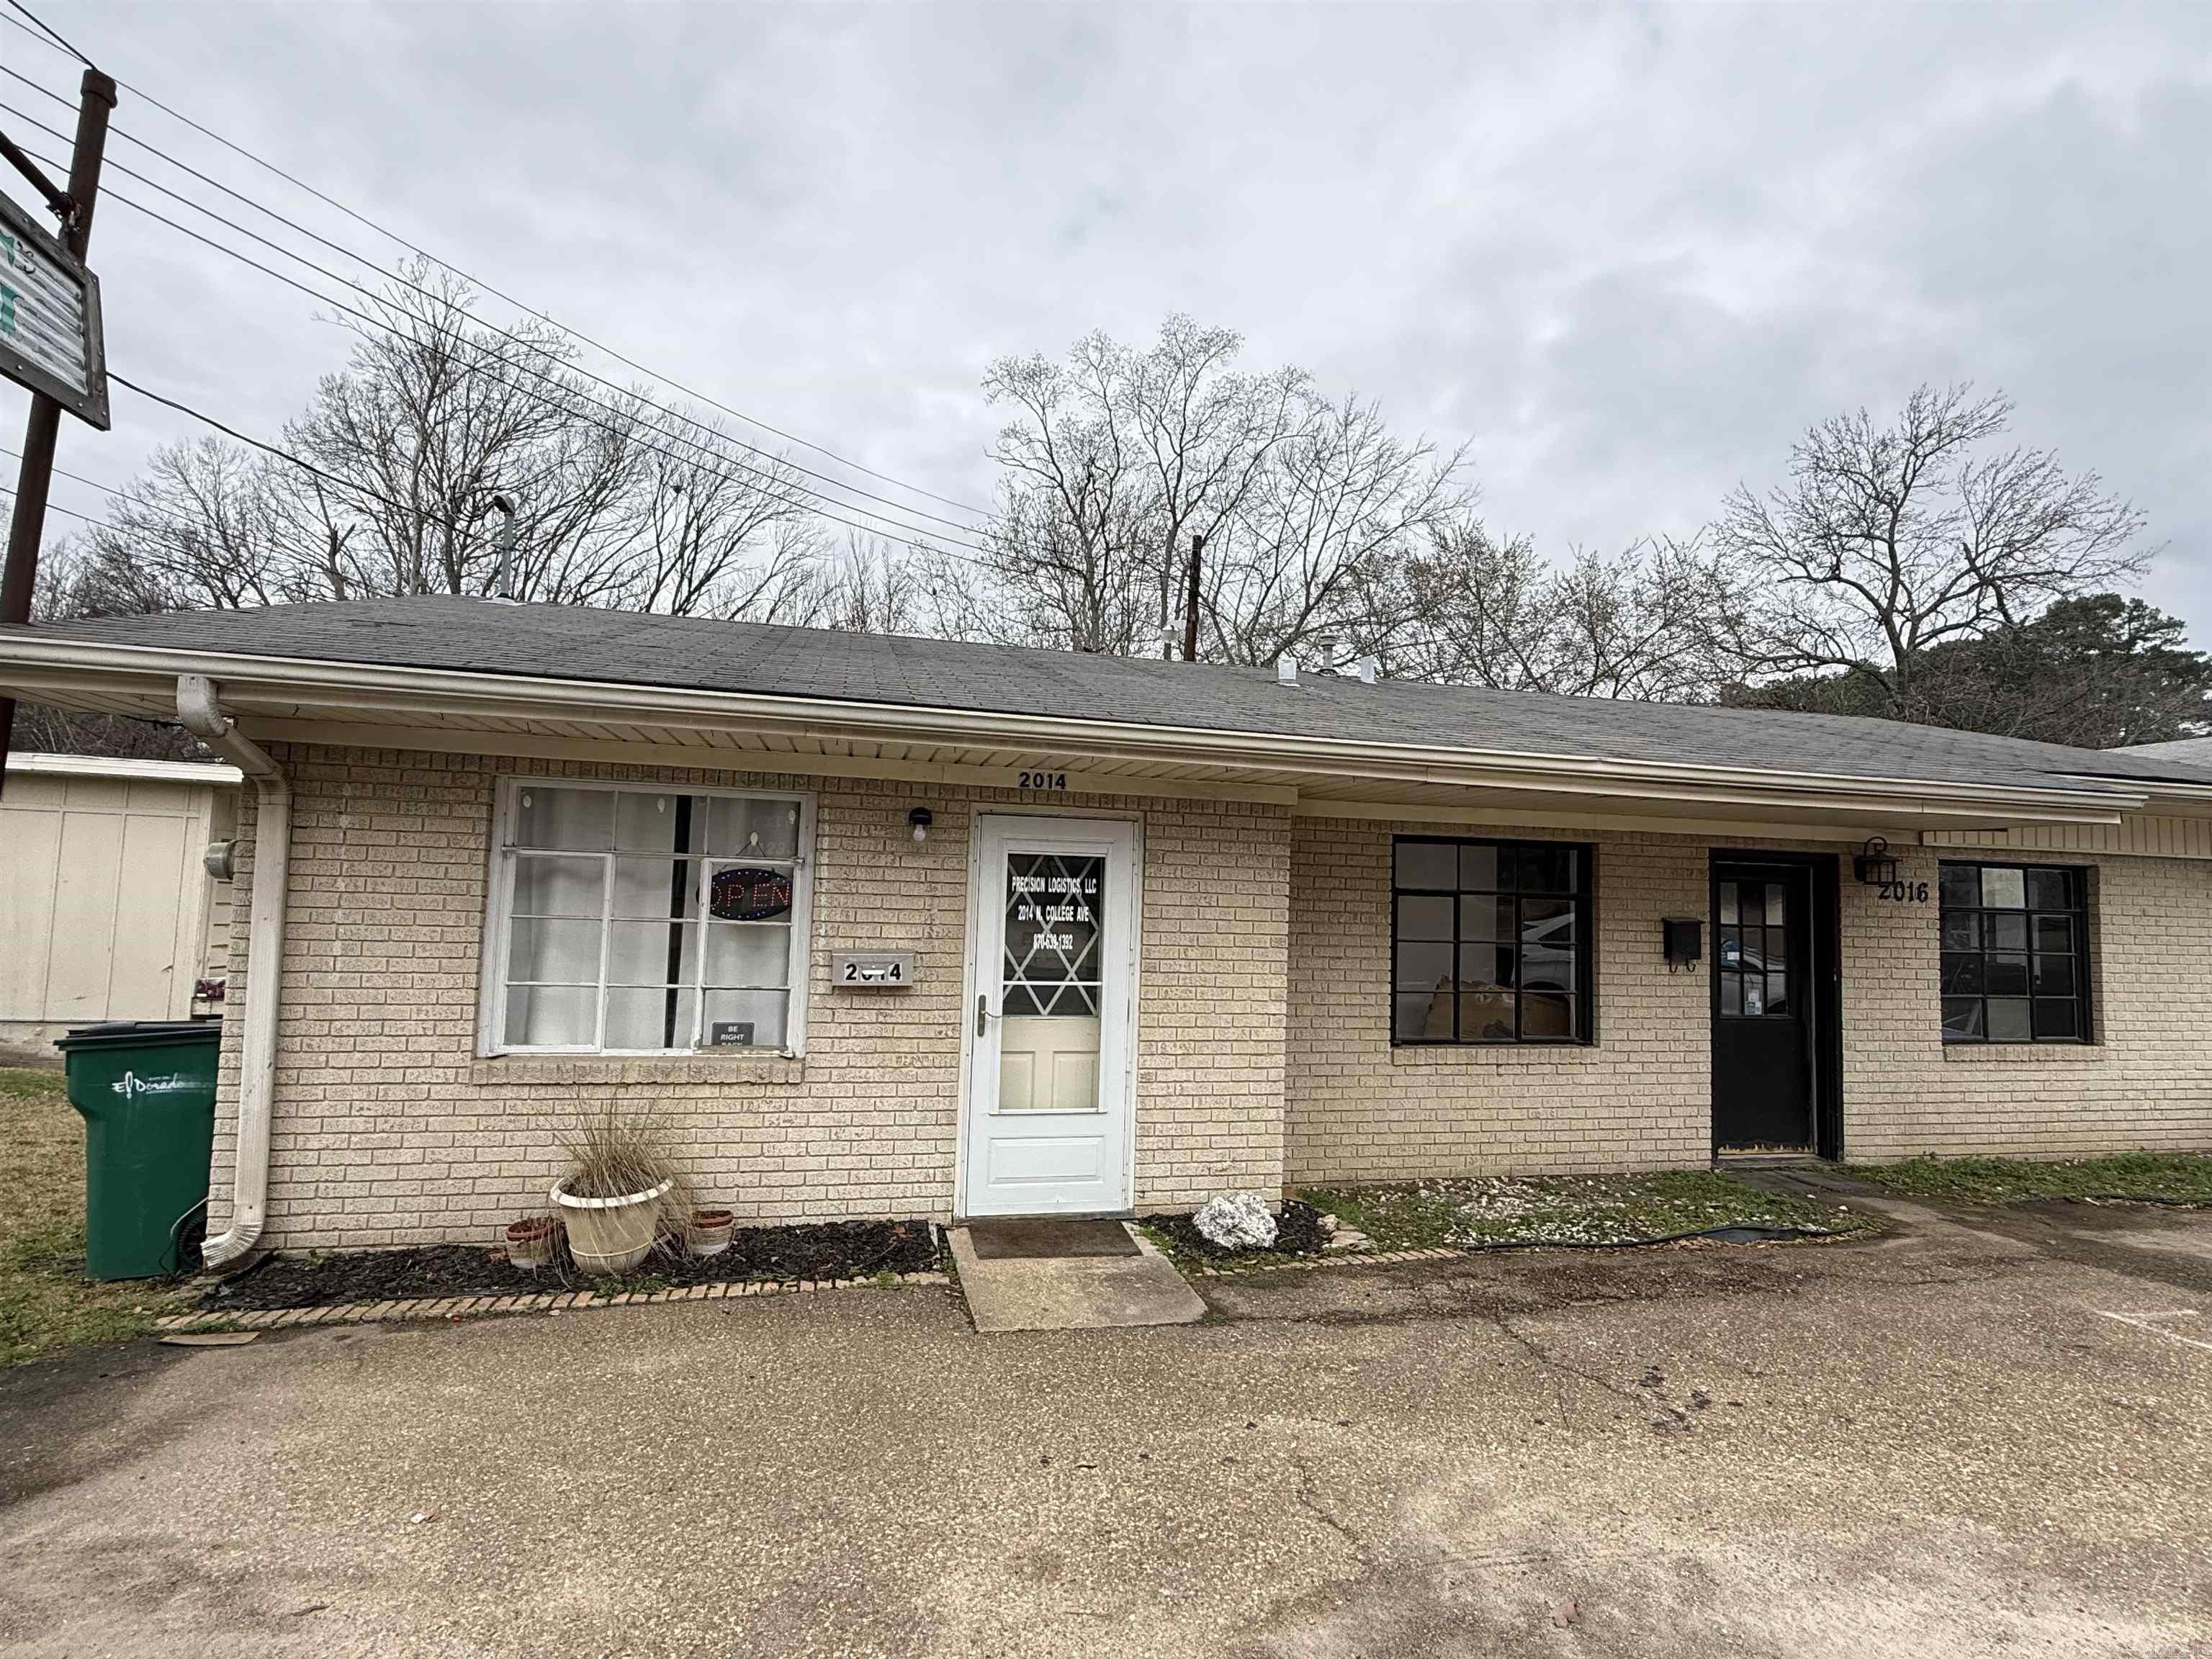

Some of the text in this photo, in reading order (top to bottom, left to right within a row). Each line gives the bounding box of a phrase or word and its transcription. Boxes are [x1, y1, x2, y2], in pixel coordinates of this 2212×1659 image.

[1019, 771, 1066, 790] 2014
[1012, 876, 1097, 896] PRECISION LOGISTICS, LLC
[1878, 881, 1928, 902] 2016
[1017, 904, 1033, 921] 2014
[1046, 905, 1074, 921] COLLEGE
